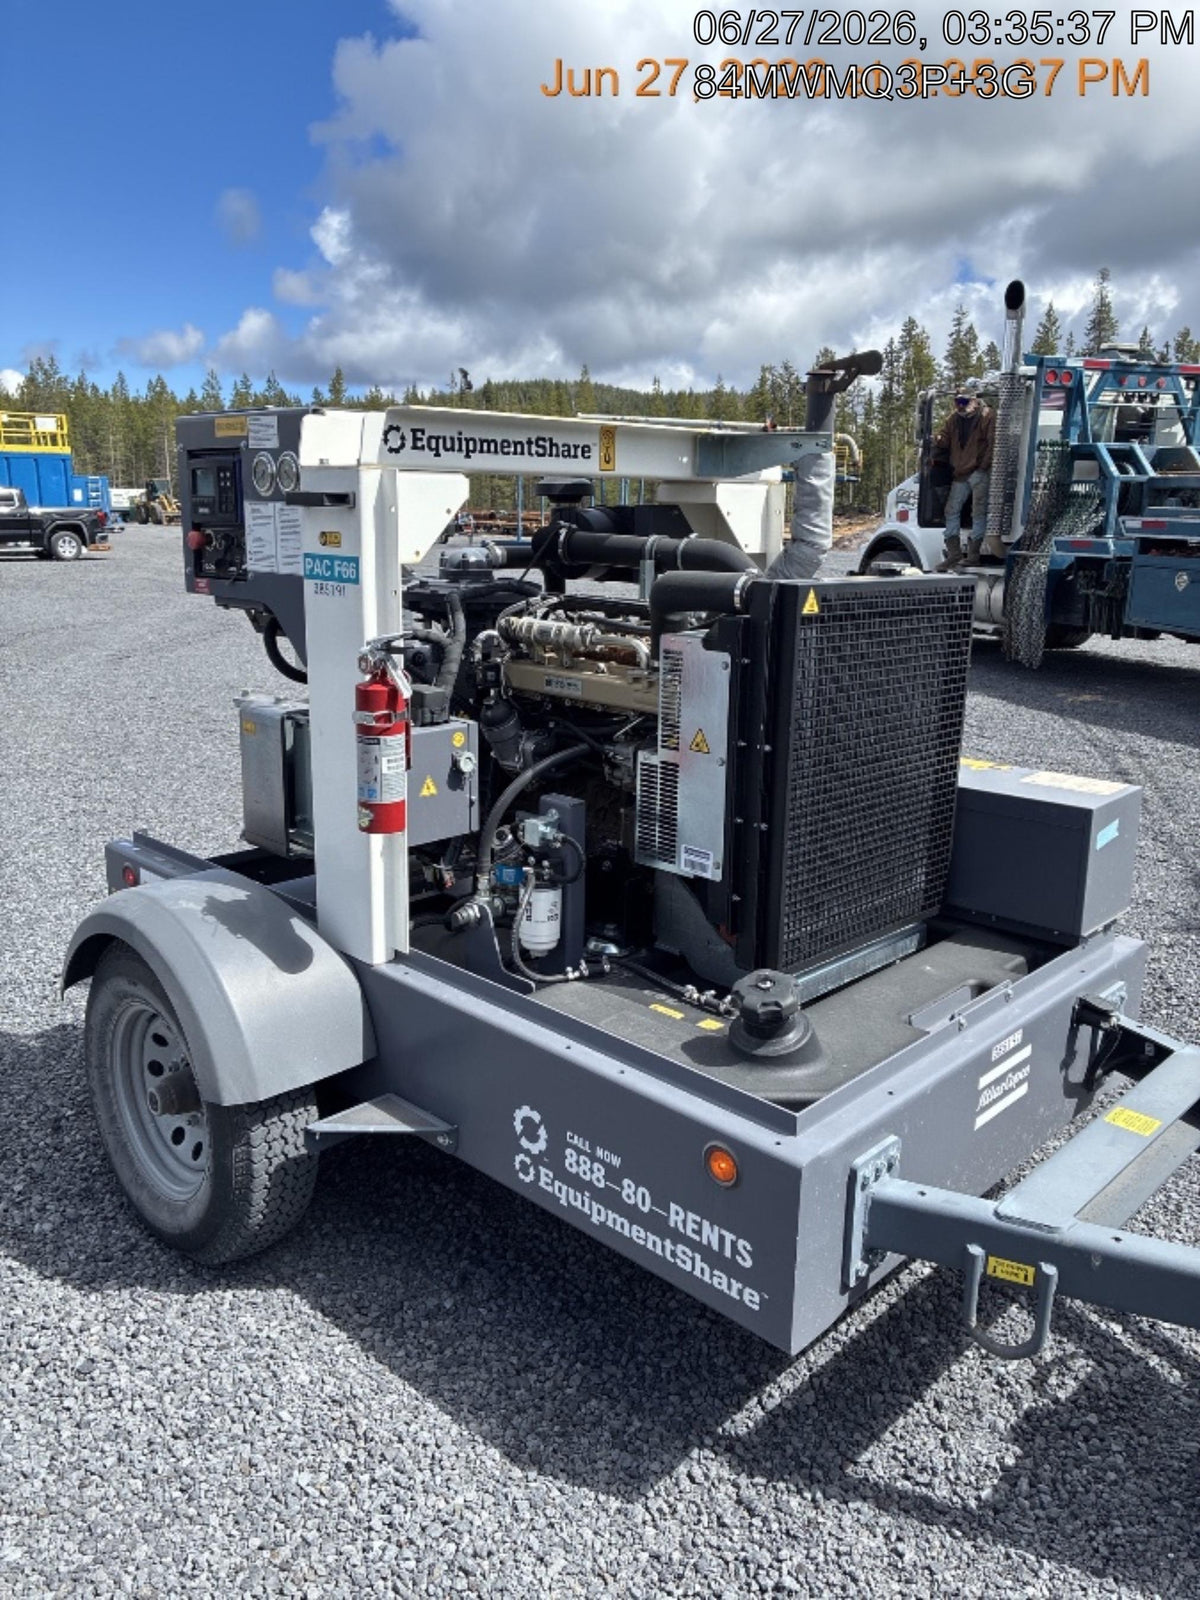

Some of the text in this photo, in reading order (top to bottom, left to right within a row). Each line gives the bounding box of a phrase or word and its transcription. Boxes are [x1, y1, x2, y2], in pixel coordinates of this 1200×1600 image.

[410, 428, 592, 459] EquipmentShare
[304, 557, 357, 579] PAC F66
[566, 1131, 622, 1169] CALL NOW
[538, 1165, 761, 1312] EquipmentShare
